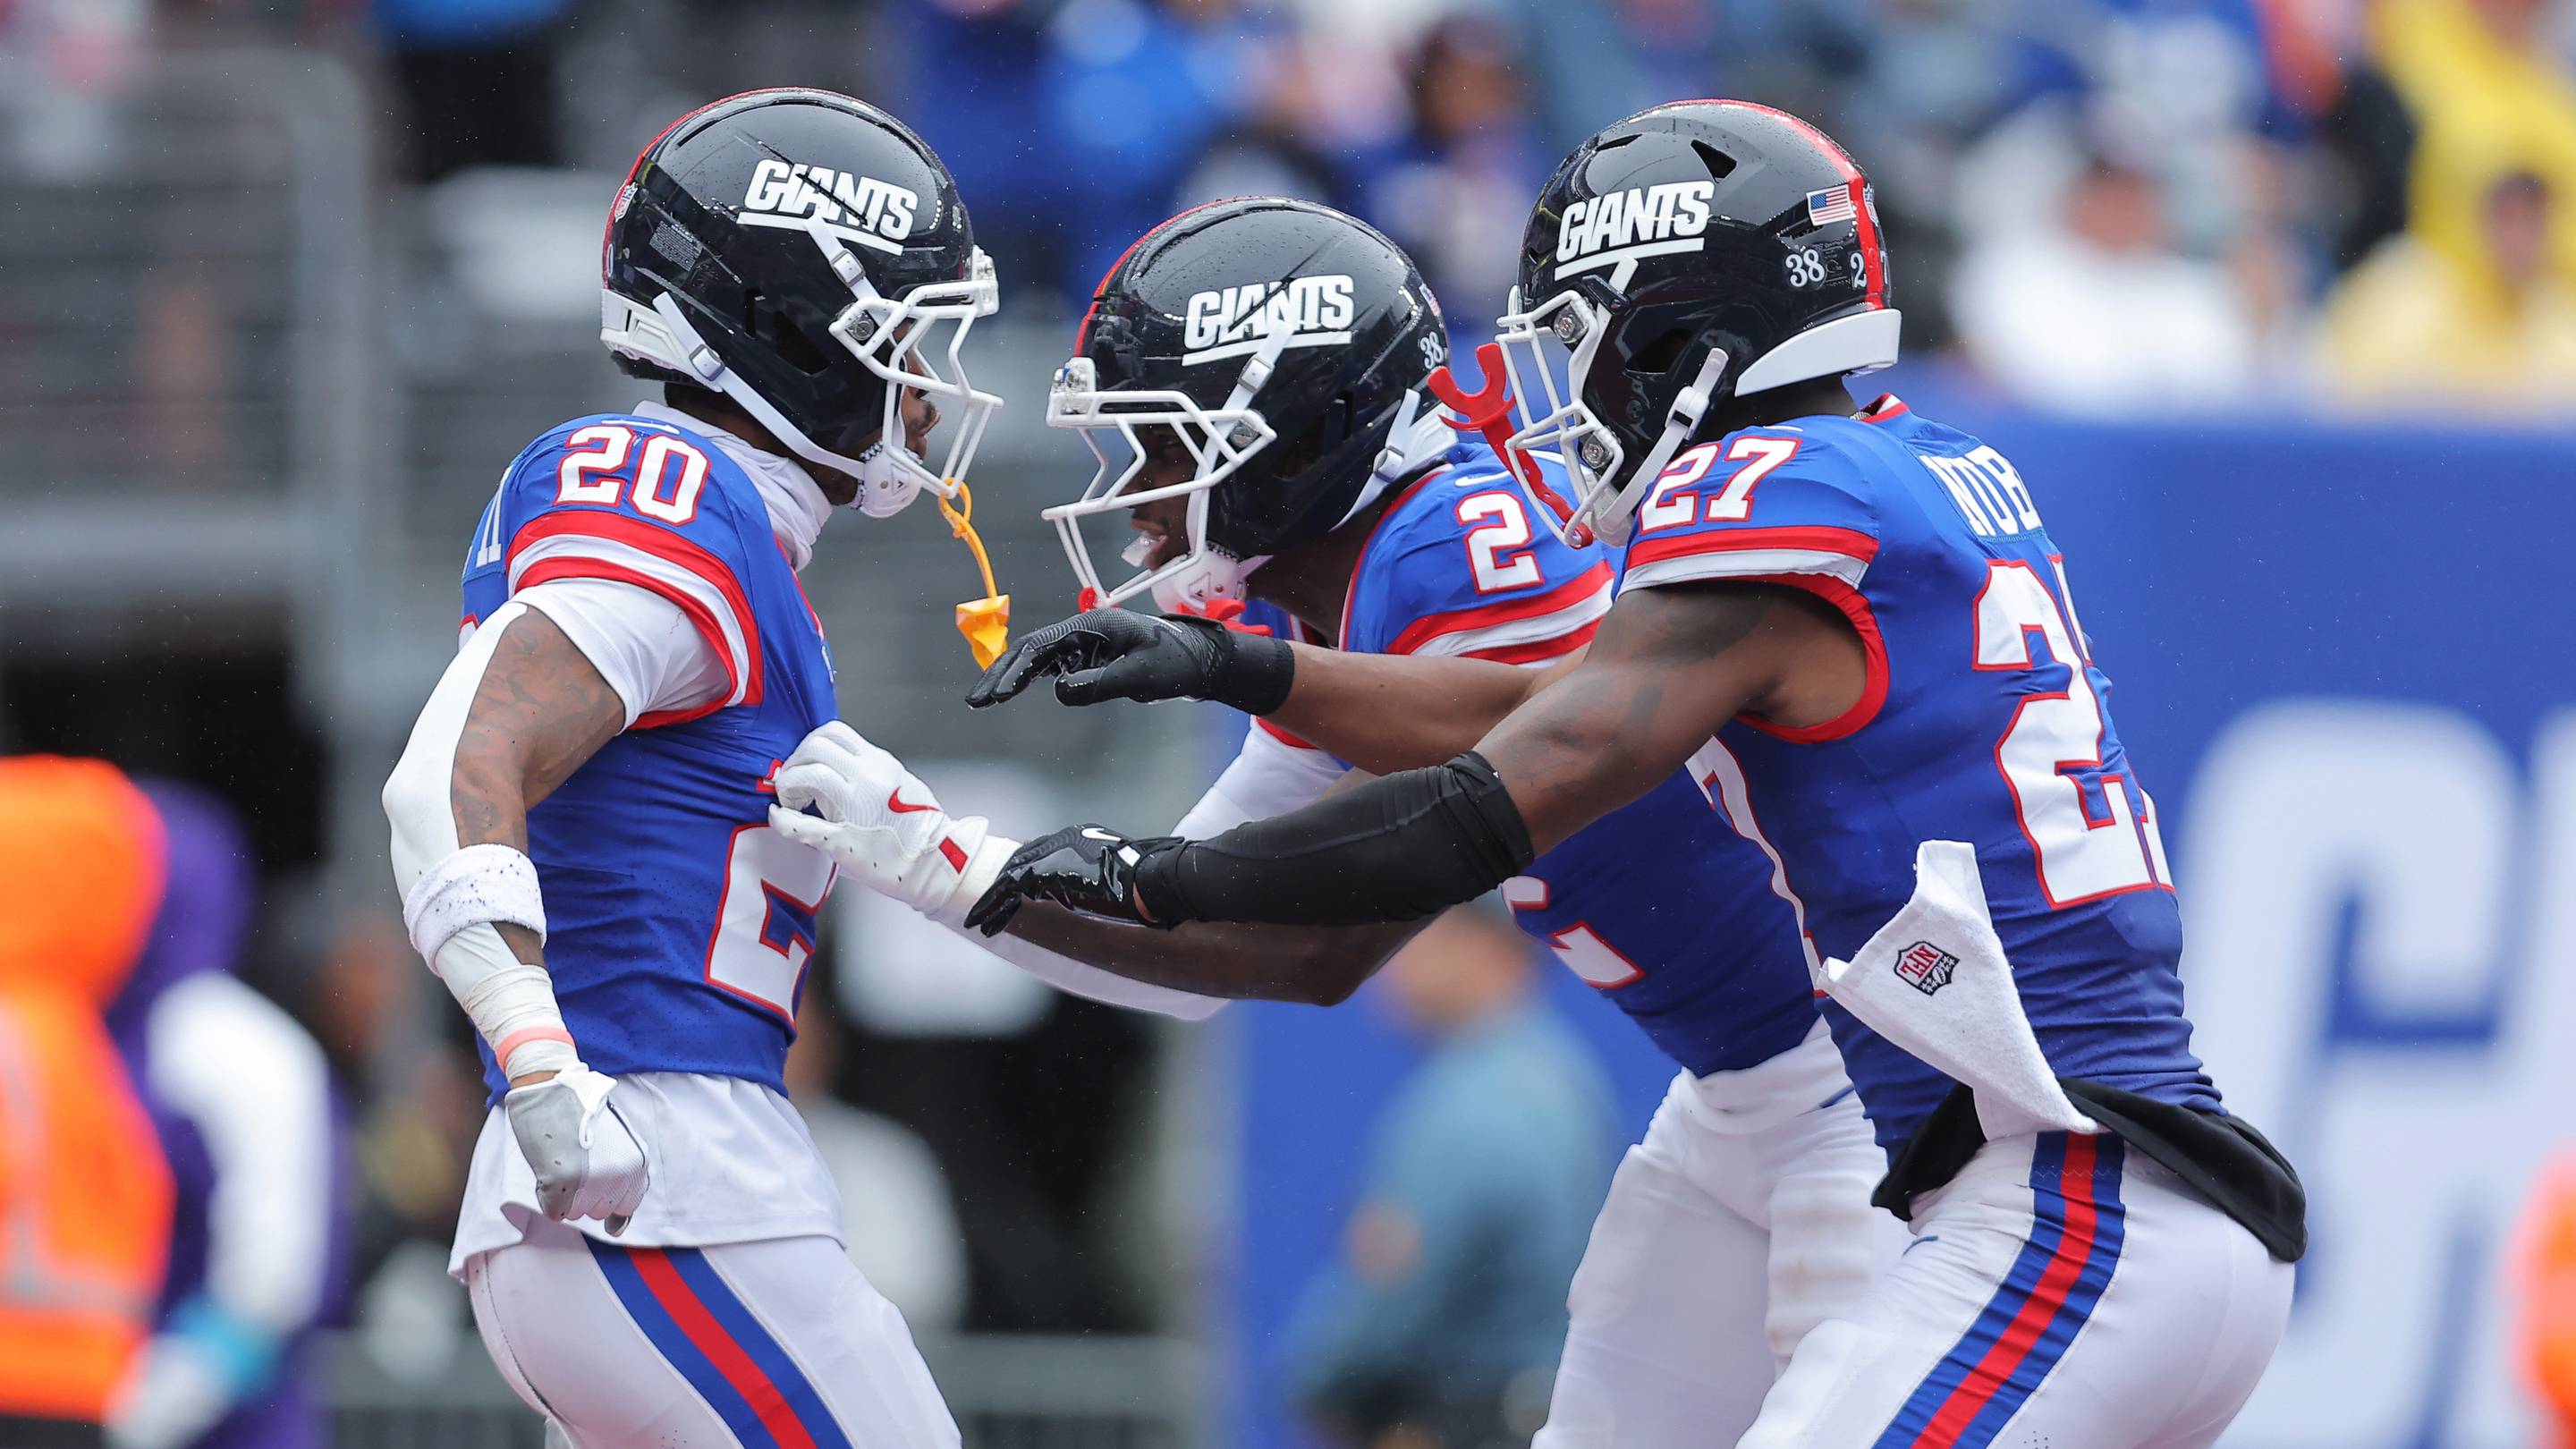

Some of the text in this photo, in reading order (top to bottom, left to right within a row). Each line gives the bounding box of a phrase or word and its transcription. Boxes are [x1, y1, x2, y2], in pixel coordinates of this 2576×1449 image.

[745, 159, 918, 241] GIANTS
[1556, 181, 1715, 262] GIANTS
[1785, 249, 1826, 288] 38
[1183, 274, 1354, 350] GIANTS
[1420, 331, 1445, 369] 38
[555, 426, 709, 525] 20
[1640, 436, 1803, 535] 27
[1455, 489, 1546, 595] 2
[1970, 555, 2175, 911] 2
[1899, 945, 1939, 979] NFL
